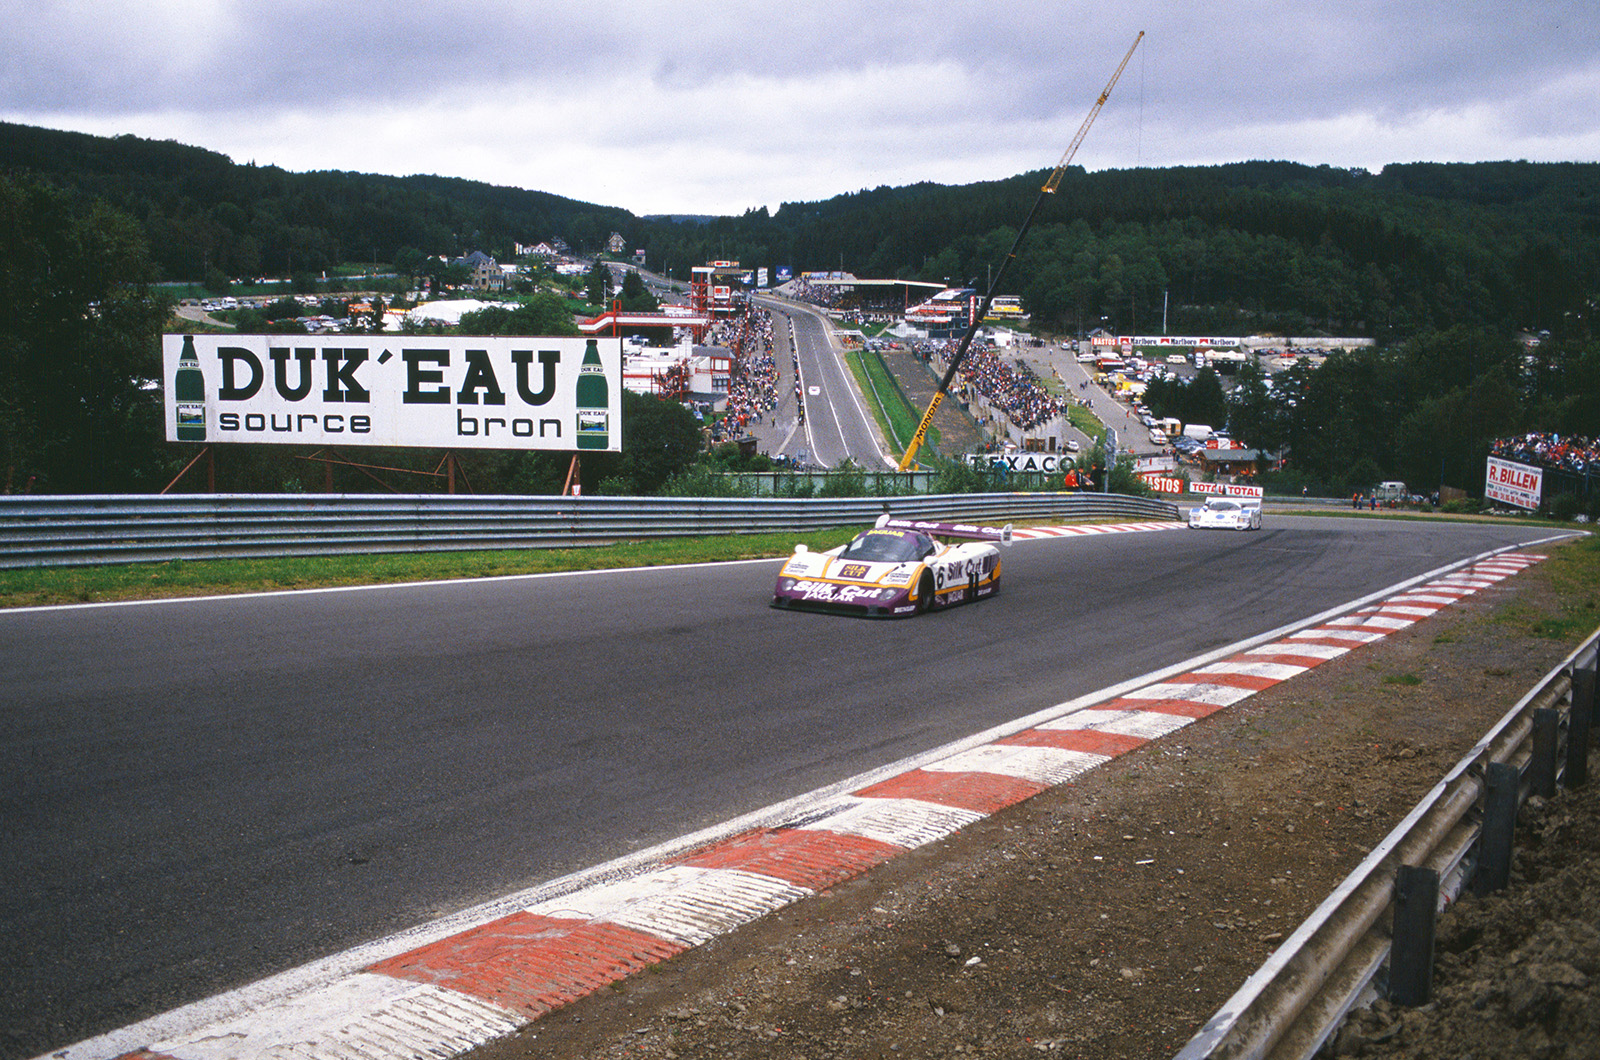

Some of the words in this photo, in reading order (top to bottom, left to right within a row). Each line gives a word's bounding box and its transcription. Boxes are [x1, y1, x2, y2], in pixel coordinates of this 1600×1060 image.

[217, 346, 561, 406] DUK'EAU
[219, 413, 371, 433] source
[457, 408, 562, 438] bron
[1489, 465, 1499, 481] R.
[1500, 467, 1539, 491] BILLEN
[1228, 486, 1260, 497] TOTAL
[866, 529, 905, 538] JAGUAR
[914, 521, 940, 529] Cut
[952, 524, 979, 532] Silk
[937, 566, 945, 589] 6
[948, 560, 964, 580] Silk
[965, 558, 982, 577] Cut
[792, 580, 838, 593] Silk
[840, 585, 882, 598] Cut
[802, 589, 857, 602] JAGUAR
